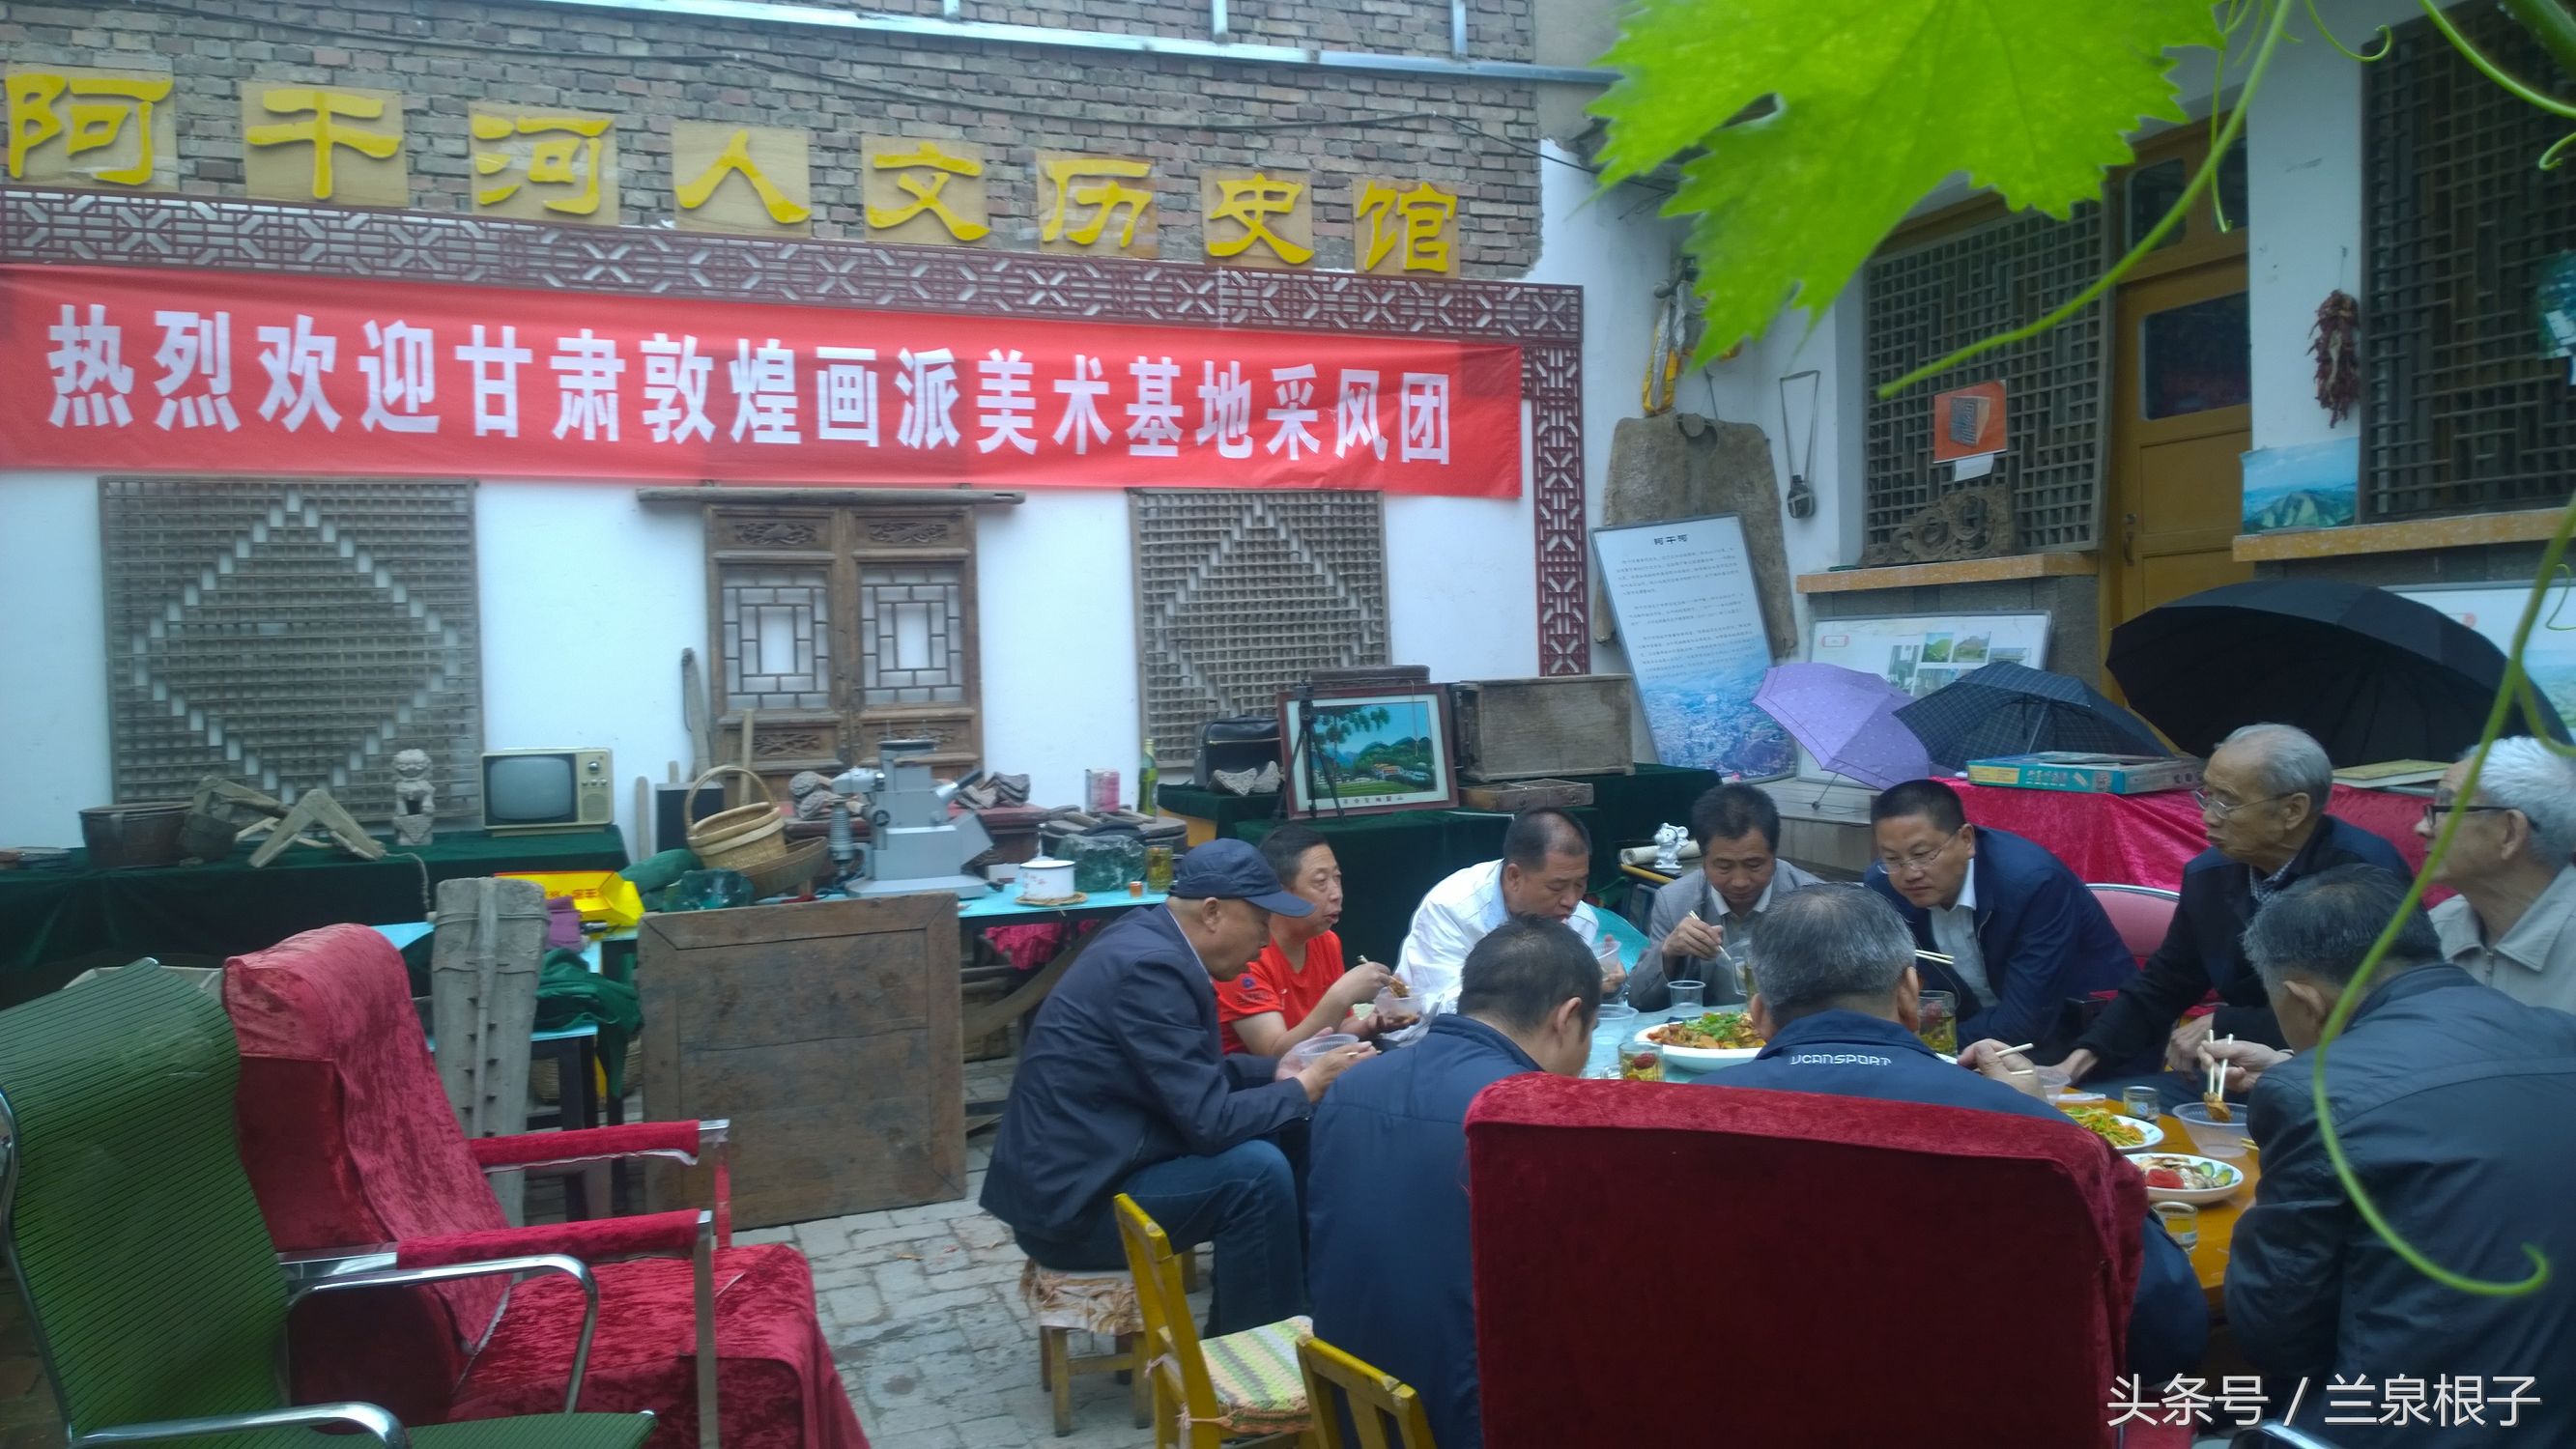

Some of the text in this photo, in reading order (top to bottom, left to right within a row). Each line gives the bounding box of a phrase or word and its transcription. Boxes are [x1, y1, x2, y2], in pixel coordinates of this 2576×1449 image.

[5, 72, 1458, 274] 阿干河人文历史馆
[46, 302, 1451, 467] 热烈欢迎甘肃敦煌画派美术基地采风团
